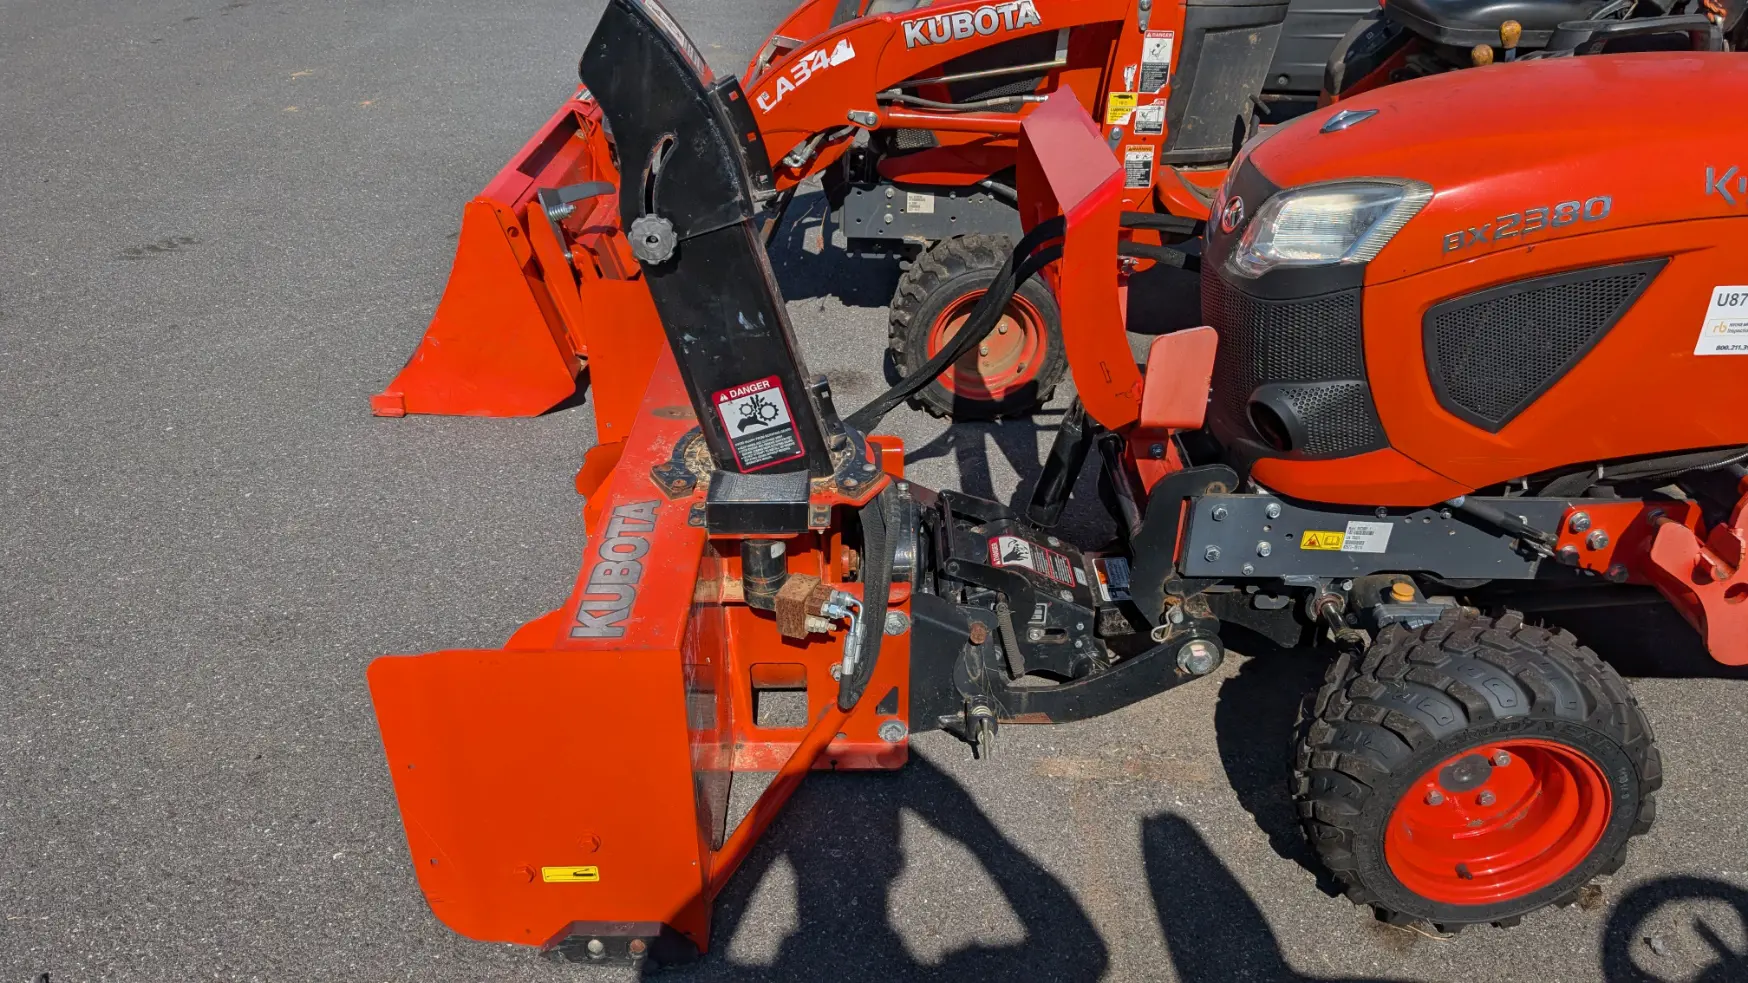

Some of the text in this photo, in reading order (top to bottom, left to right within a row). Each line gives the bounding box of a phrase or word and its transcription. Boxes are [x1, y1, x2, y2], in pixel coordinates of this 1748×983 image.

[903, 0, 1041, 49] KUBOTA
[1705, 166, 1748, 206] K
[1443, 195, 1612, 252] BX2380
[1717, 292, 1748, 306] U87
[729, 379, 771, 398] DANGER
[571, 498, 663, 639] KUBOTA
